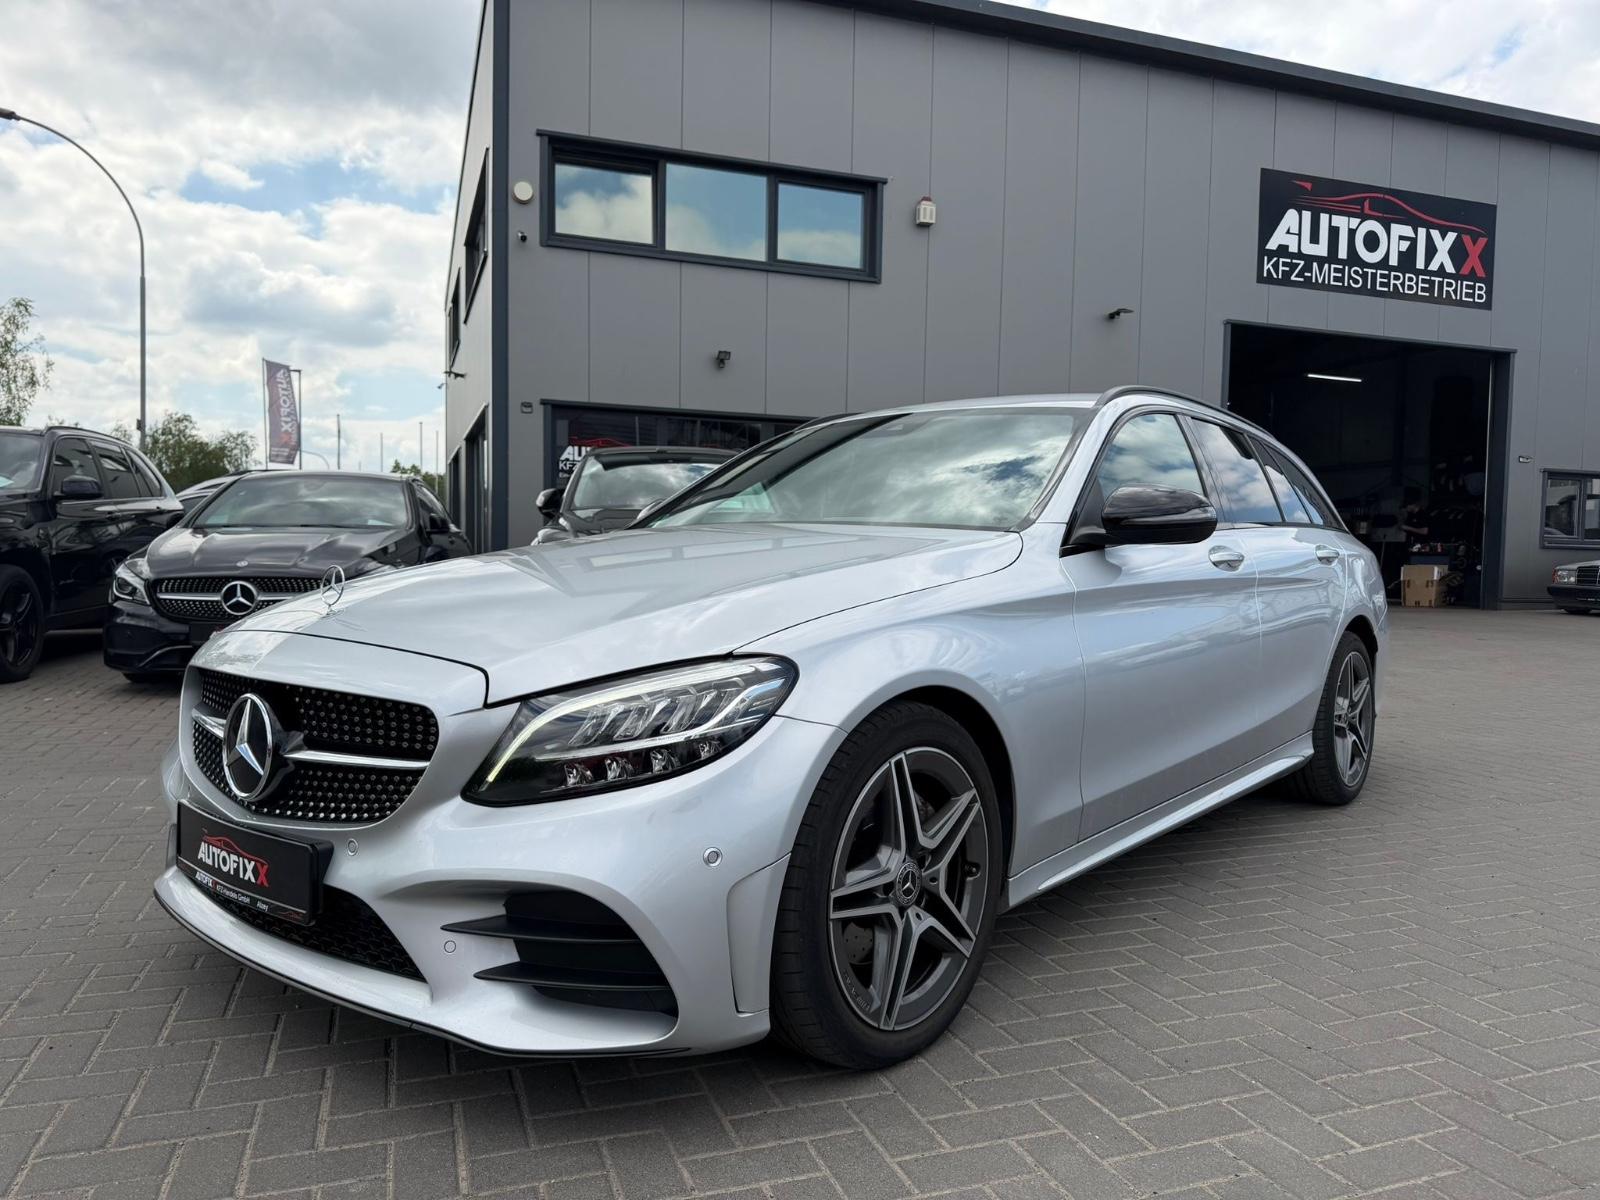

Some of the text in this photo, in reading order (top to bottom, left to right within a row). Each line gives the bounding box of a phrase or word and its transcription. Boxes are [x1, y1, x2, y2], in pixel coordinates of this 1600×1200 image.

[1265, 208, 1488, 277] AUTOFIXX
[1263, 256, 1486, 302] KFZ-MEISTERBETRIEB
[198, 841, 270, 888] AUTOFIXX
